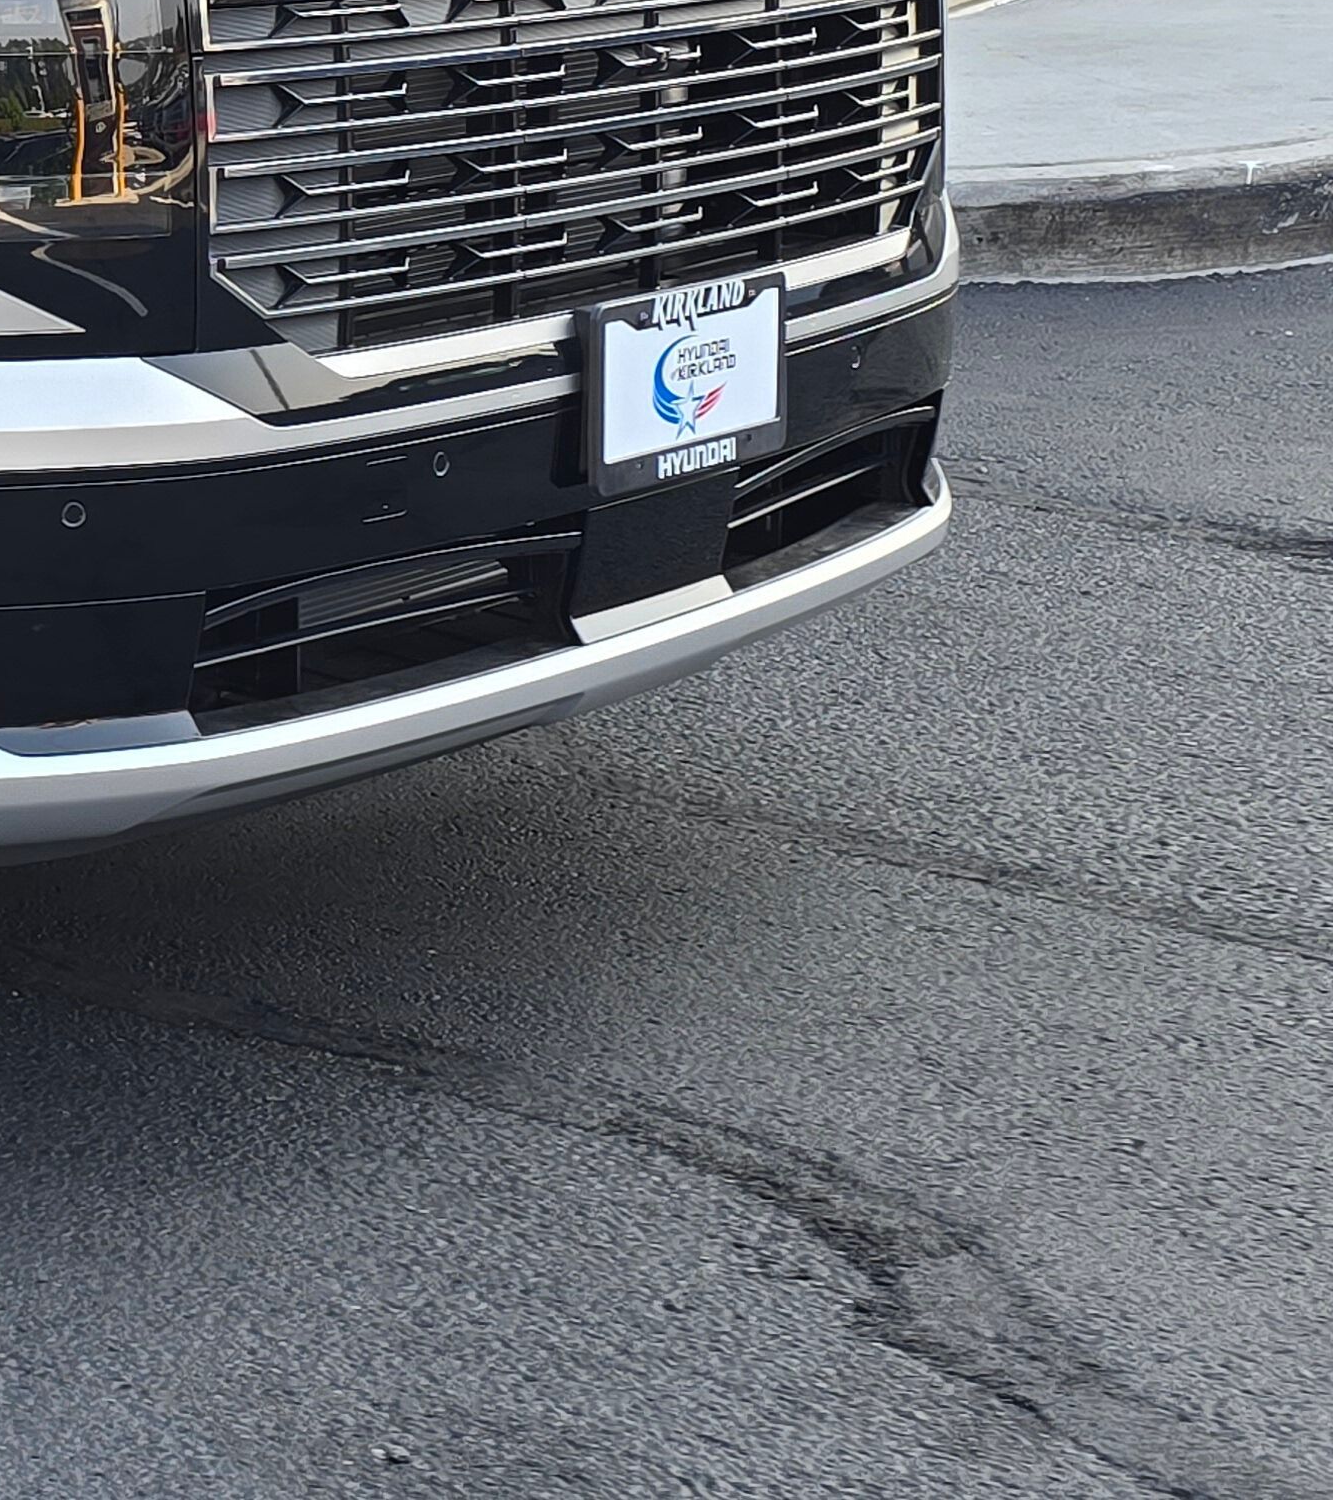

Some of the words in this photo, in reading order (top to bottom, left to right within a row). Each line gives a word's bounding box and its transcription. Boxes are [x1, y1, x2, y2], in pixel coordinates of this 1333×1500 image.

[652, 280, 745, 331] KIRKLAND
[677, 353, 737, 382] KIRKLAND
[657, 436, 737, 480] HYUNDAI
